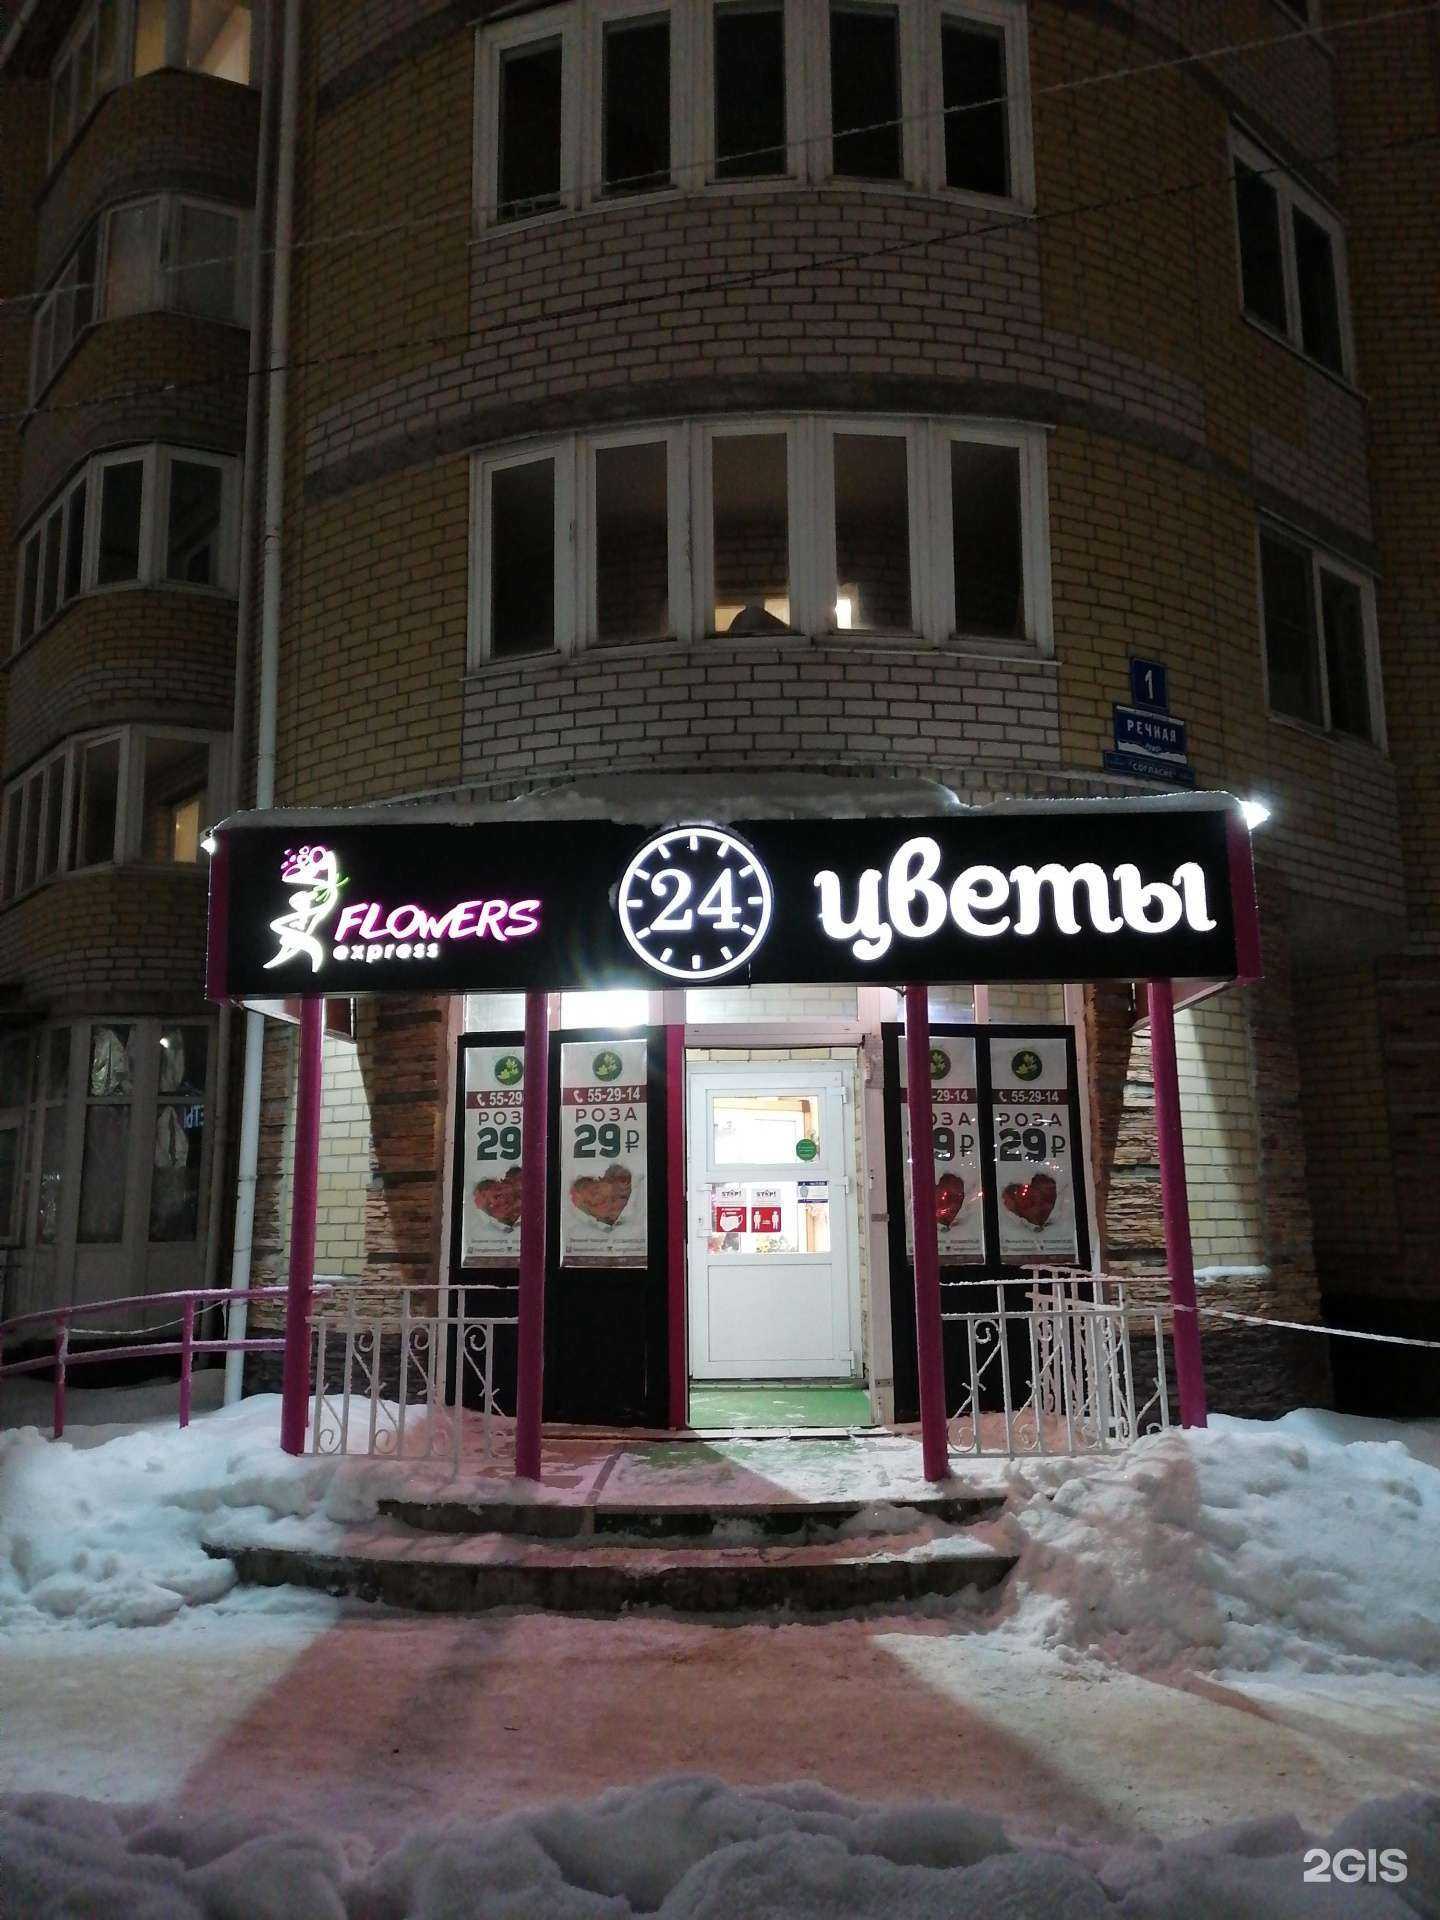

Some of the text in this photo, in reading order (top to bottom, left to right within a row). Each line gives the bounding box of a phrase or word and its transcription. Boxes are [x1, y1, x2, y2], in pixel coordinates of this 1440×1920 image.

[1145, 669, 1153, 699] 1
[1127, 719, 1177, 742] РЕЧНАЯ
[650, 868, 742, 931] 24
[813, 836, 1217, 961] цветы
[334, 899, 541, 942] FLOWERS
[332, 942, 439, 963] express
[489, 1091, 523, 1106] 55-29
[587, 1087, 641, 1102] 55-29-14
[932, 1090, 968, 1101] -29-14
[1011, 1090, 1059, 1102] 55-29-14
[478, 1111, 521, 1126] РОЗ
[575, 1107, 637, 1123] РОЗА
[999, 1112, 1062, 1127] РОЗА
[477, 1126, 521, 1160] 29
[933, 1127, 955, 1161] 9
